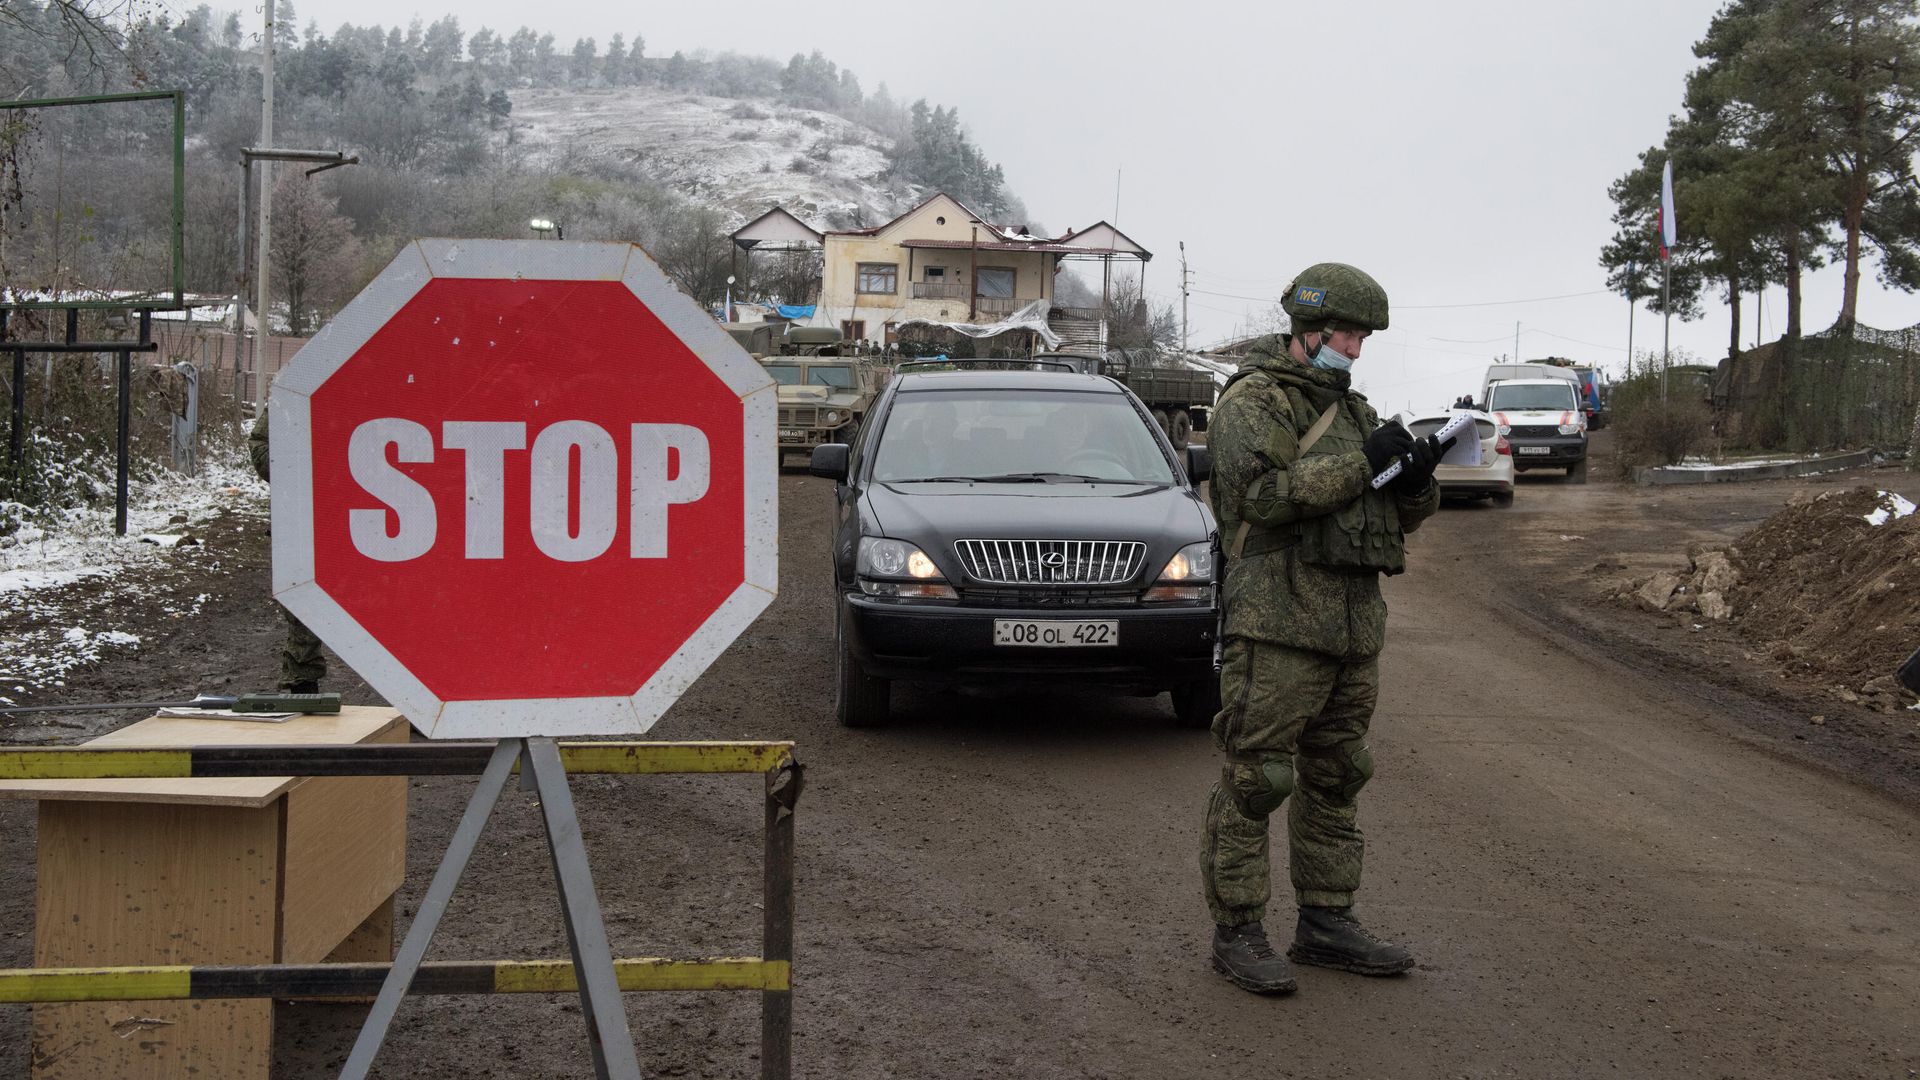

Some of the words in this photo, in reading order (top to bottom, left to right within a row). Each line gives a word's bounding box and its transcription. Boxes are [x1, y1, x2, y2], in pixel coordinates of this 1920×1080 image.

[347, 417, 711, 562] STOP
[1013, 623, 1038, 643] 08
[1043, 628, 1066, 643] OL
[1072, 624, 1109, 643] 422
